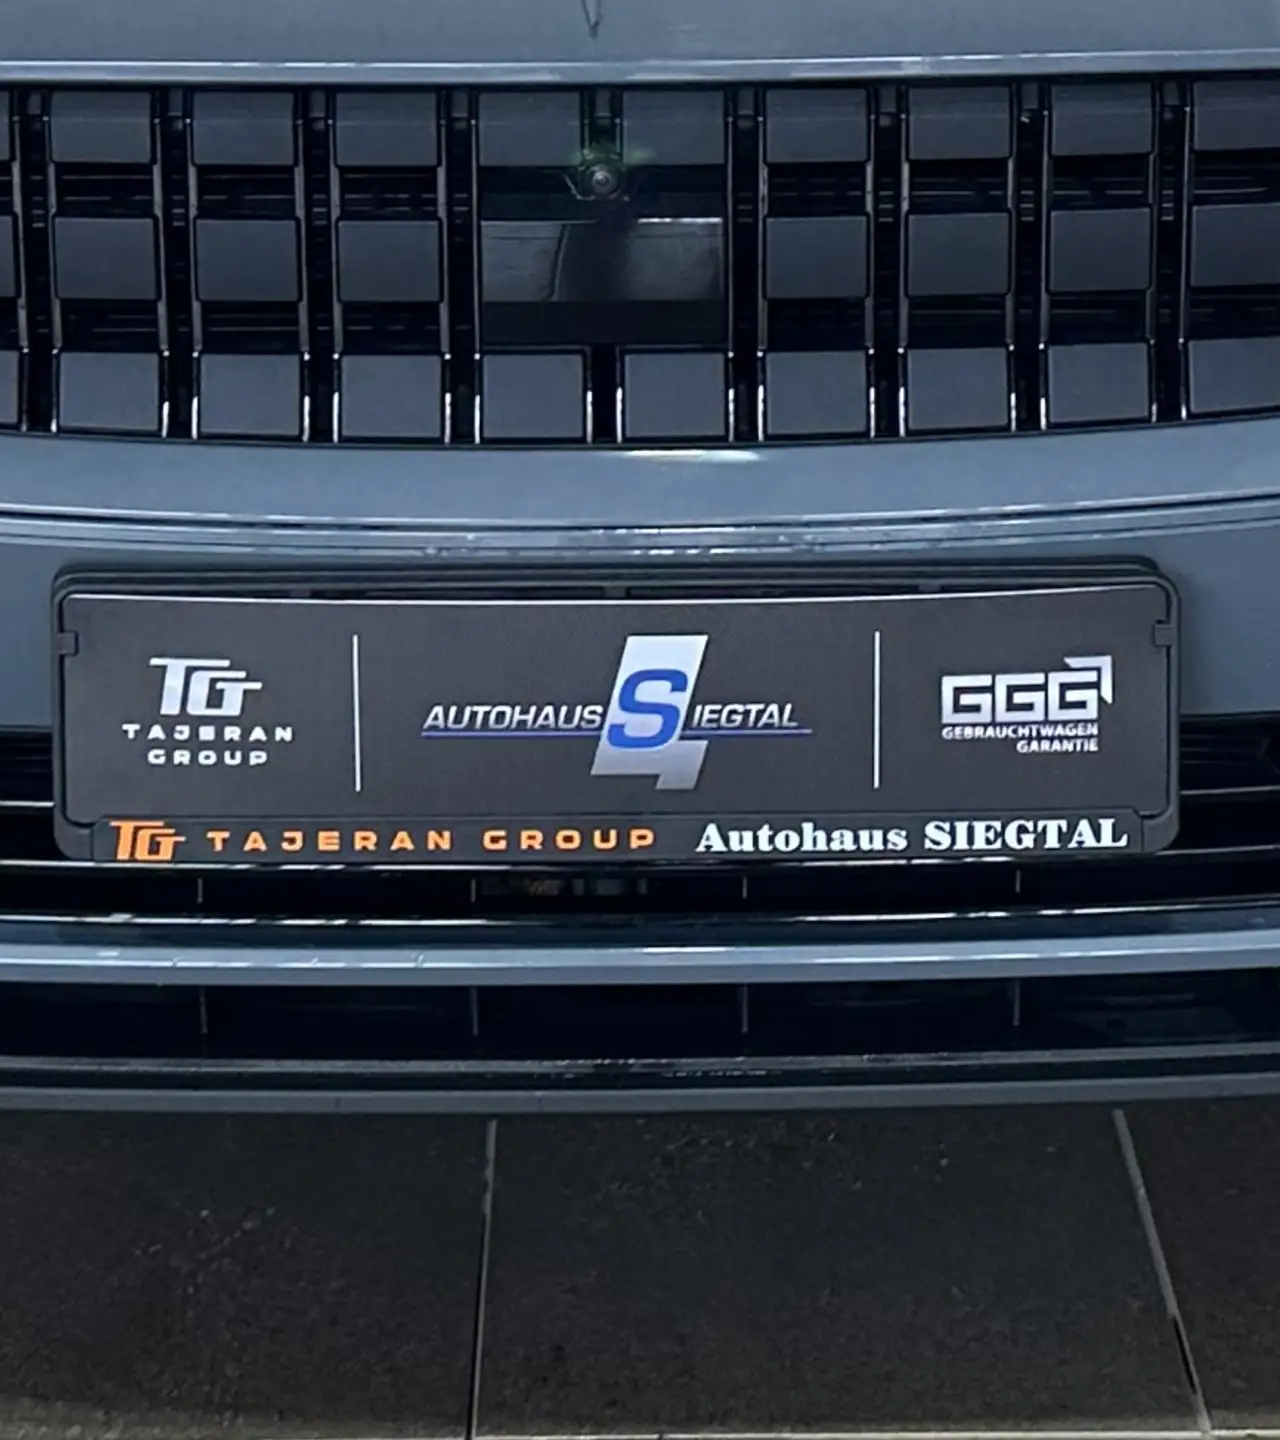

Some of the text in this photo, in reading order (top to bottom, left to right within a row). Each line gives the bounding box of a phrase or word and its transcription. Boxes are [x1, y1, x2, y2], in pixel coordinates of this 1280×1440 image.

[941, 670, 1099, 725] GGG
[423, 704, 604, 731] AUTOHAUS
[122, 723, 294, 742] TAJERAN
[942, 722, 1098, 740] GEBRAUCHTWAGEN
[1016, 738, 1099, 753] GARANTIE
[147, 749, 268, 766] GROUP
[206, 830, 452, 852] TAJERAN
[483, 828, 656, 851] GROUP
[695, 822, 909, 853] Autohaus
[924, 818, 1129, 851] SIEGTAL
